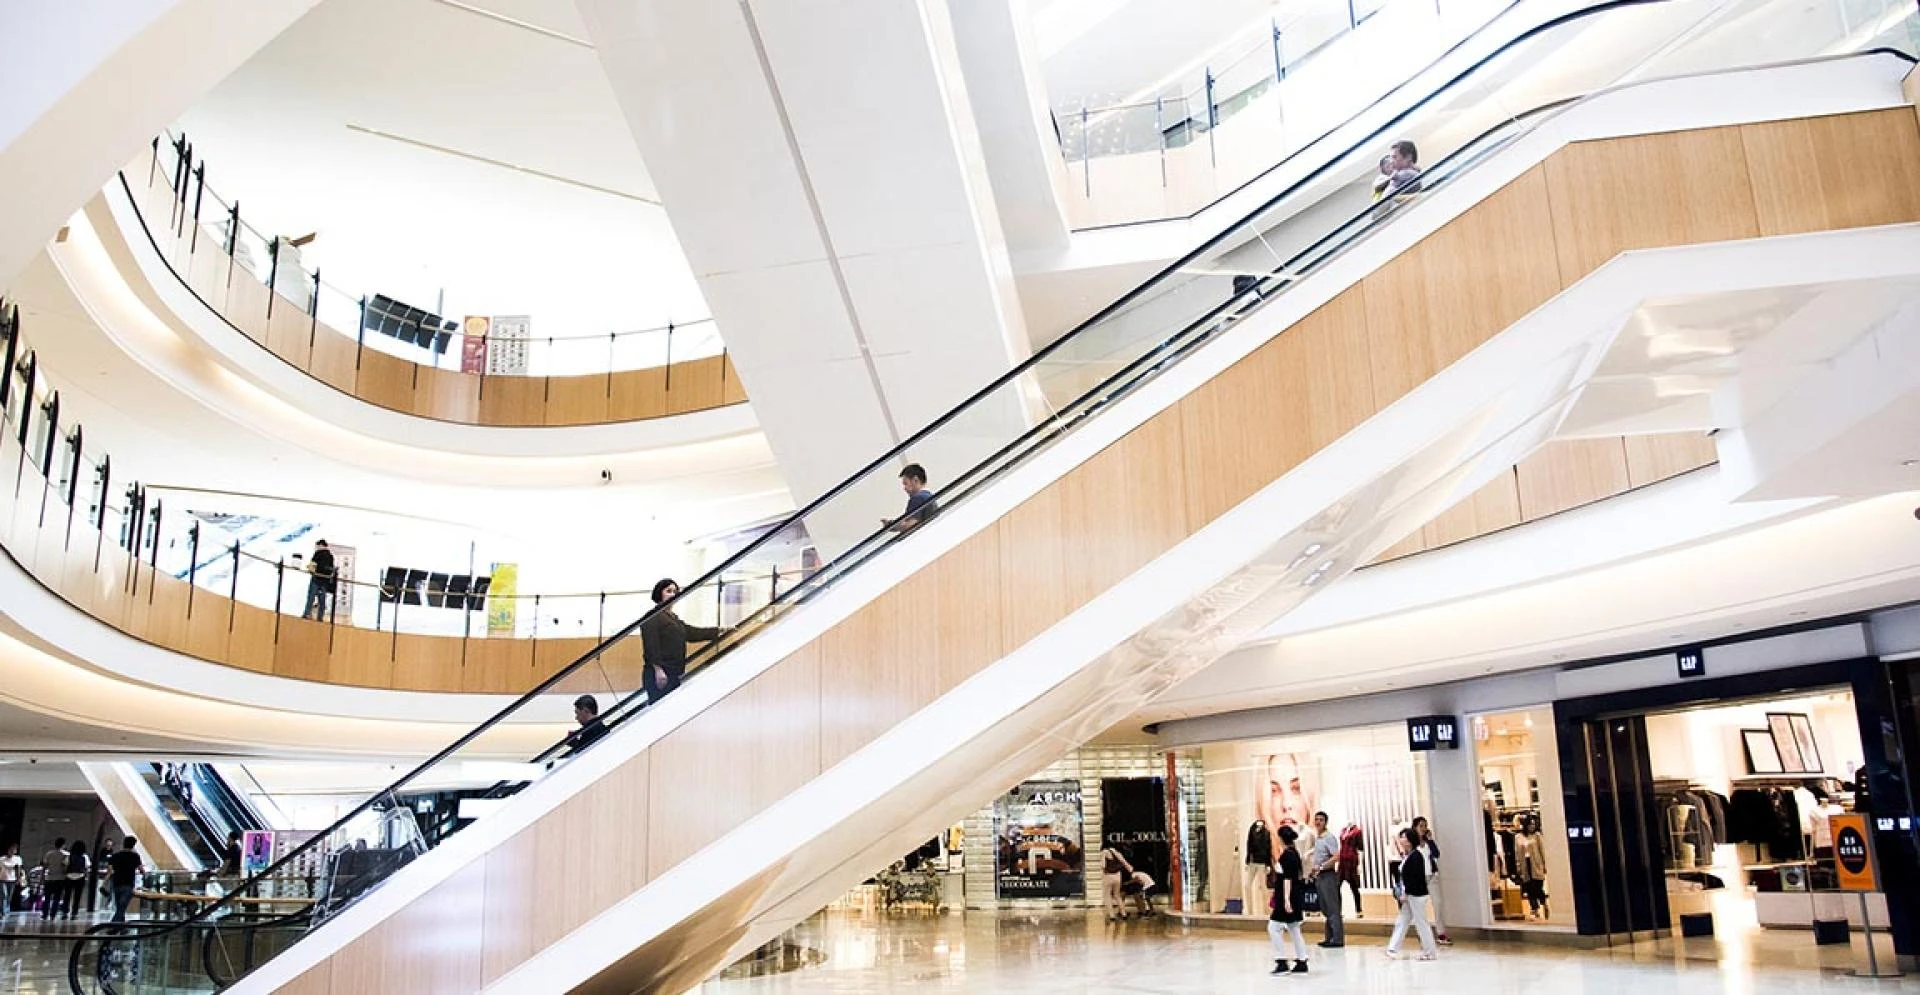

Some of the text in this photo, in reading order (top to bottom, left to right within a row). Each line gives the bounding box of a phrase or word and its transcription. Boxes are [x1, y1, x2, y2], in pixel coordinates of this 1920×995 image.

[1680, 655, 1698, 671] GAP
[1412, 724, 1430, 742] GAP
[1436, 724, 1453, 740] GAP
